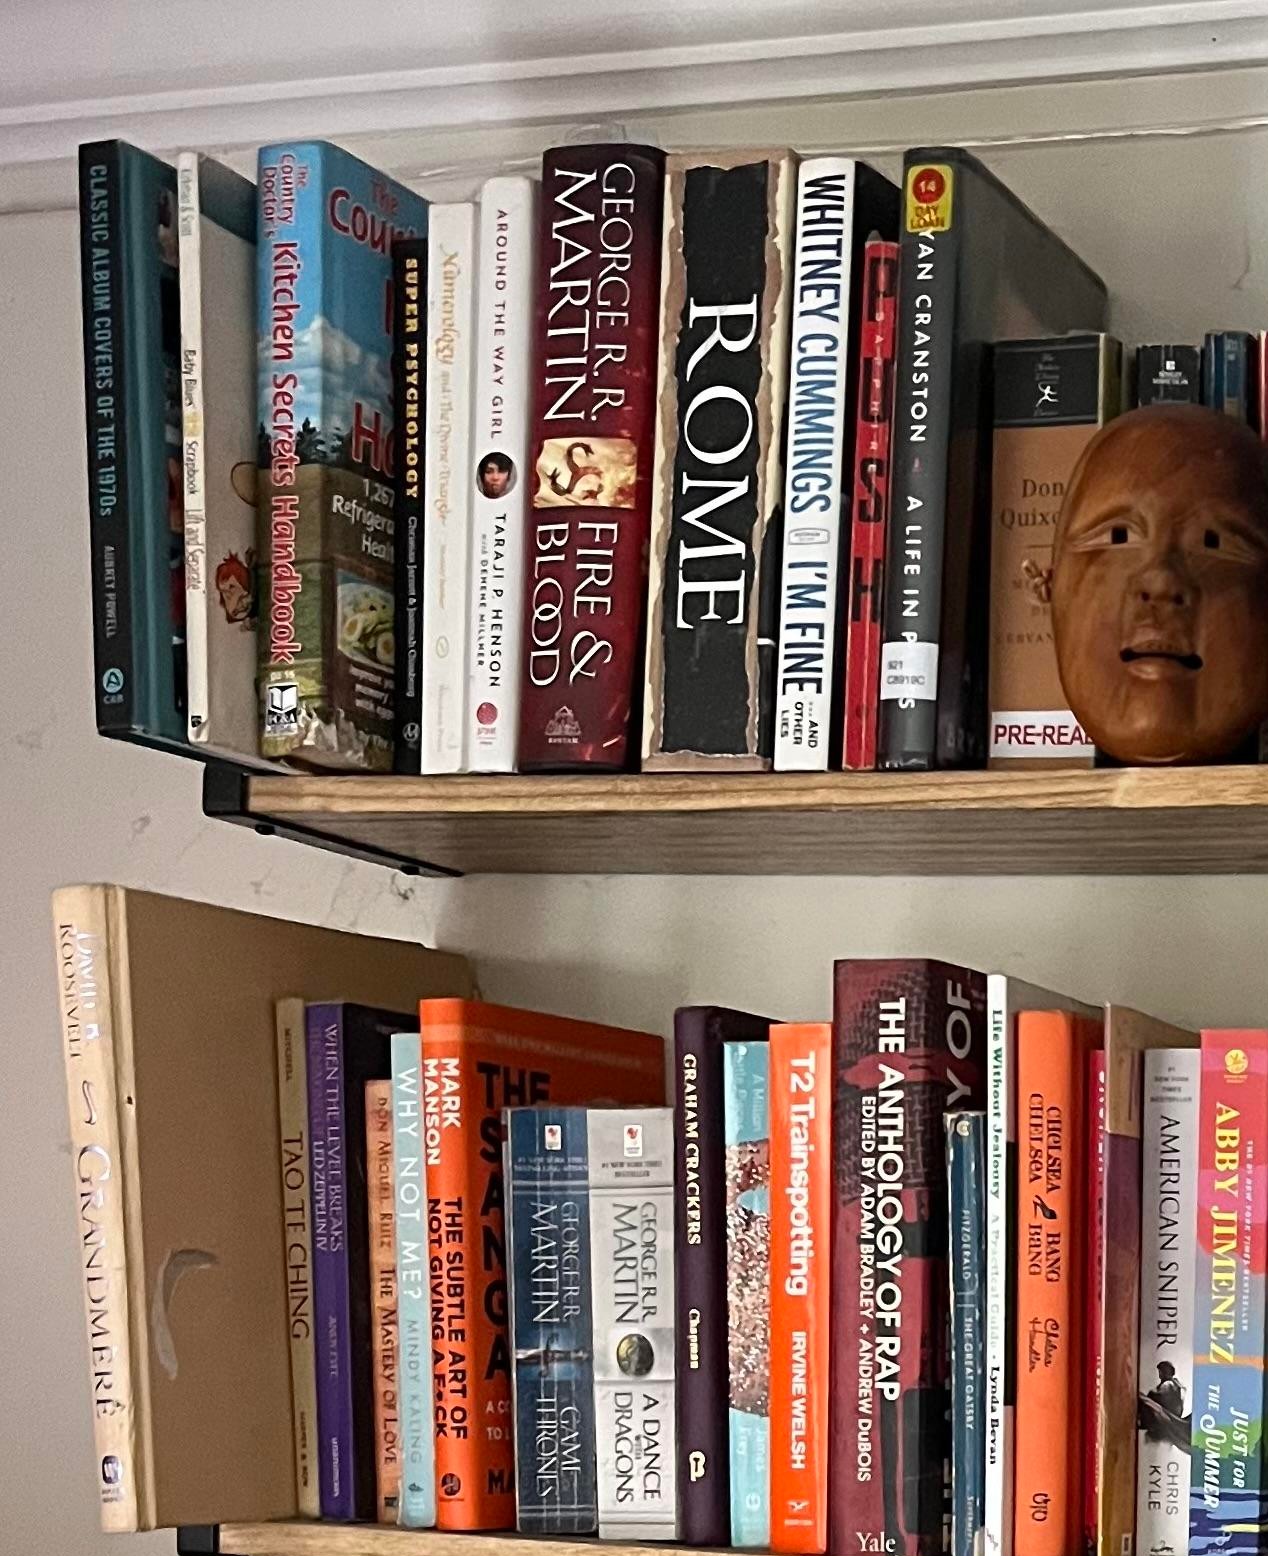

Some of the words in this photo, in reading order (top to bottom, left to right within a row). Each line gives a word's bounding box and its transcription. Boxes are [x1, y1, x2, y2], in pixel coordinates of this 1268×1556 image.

[90, 164, 109, 246] CLASSIC
[92, 247, 111, 314] ALBUM
[493, 209, 508, 290] AROUND
[798, 174, 845, 322] WHITNEY
[272, 241, 300, 360] Kitchen
[405, 258, 419, 333] SUPER
[492, 302, 505, 335] THE
[543, 167, 597, 422] MARTIN
[94, 317, 113, 391] COVERS
[491, 346, 505, 386] WAY
[910, 295, 932, 442] CRANSTON
[96, 395, 113, 420] OF
[97, 425, 115, 460] THE
[271, 373, 298, 486] Secrets
[405, 344, 419, 499] PSYCHOLOGY
[491, 397, 504, 439] GIRL
[790, 333, 837, 513] CUMMINGS
[98, 466, 116, 517] 1970s
[677, 294, 758, 630] ROME
[104, 546, 116, 588] AUBREY
[271, 496, 301, 664] Handbook
[573, 522, 618, 615] FIRE
[789, 560, 827, 610] I'M
[105, 592, 117, 638] POWELL
[530, 523, 568, 686] BLOOD
[570, 631, 613, 687] &
[782, 621, 824, 695] FINE
[879, 998, 906, 1053] THE
[683, 1054, 699, 1138] GRAHAM
[790, 1053, 815, 1092] T2
[862, 1096, 877, 1151] EDITED
[1213, 1102, 1240, 1192] ABBY
[283, 1132, 305, 1191] TAO
[686, 1143, 701, 1244] CRACKERS
[861, 1156, 875, 1178] BY
[876, 1064, 904, 1276] ANTHOLOGY
[1157, 1116, 1181, 1250] AMERICAN
[786, 1103, 814, 1295] Trainspotting
[860, 1183, 875, 1238] ADAM
[860, 1244, 875, 1319] BRADLEY
[961, 1211, 972, 1280] FITZGERALD
[289, 1242, 310, 1338] CHING
[876, 1282, 902, 1327] OF
[1155, 1261, 1178, 1349] SNIPER
[1209, 1206, 1236, 1366] JIMENEZ
[406, 1319, 422, 1382] MINDY
[792, 1331, 806, 1395] IRVINE
[858, 1339, 873, 1412] ANDREW
[875, 1336, 901, 1401] RAP
[988, 1366, 1000, 1412] Lynda
[408, 1394, 423, 1463] KALING
[791, 1397, 806, 1469] WELSH
[857, 1419, 871, 1481] DuBOIS
[989, 1418, 1000, 1465] Bevan
[856, 1531, 896, 1555] Yale
